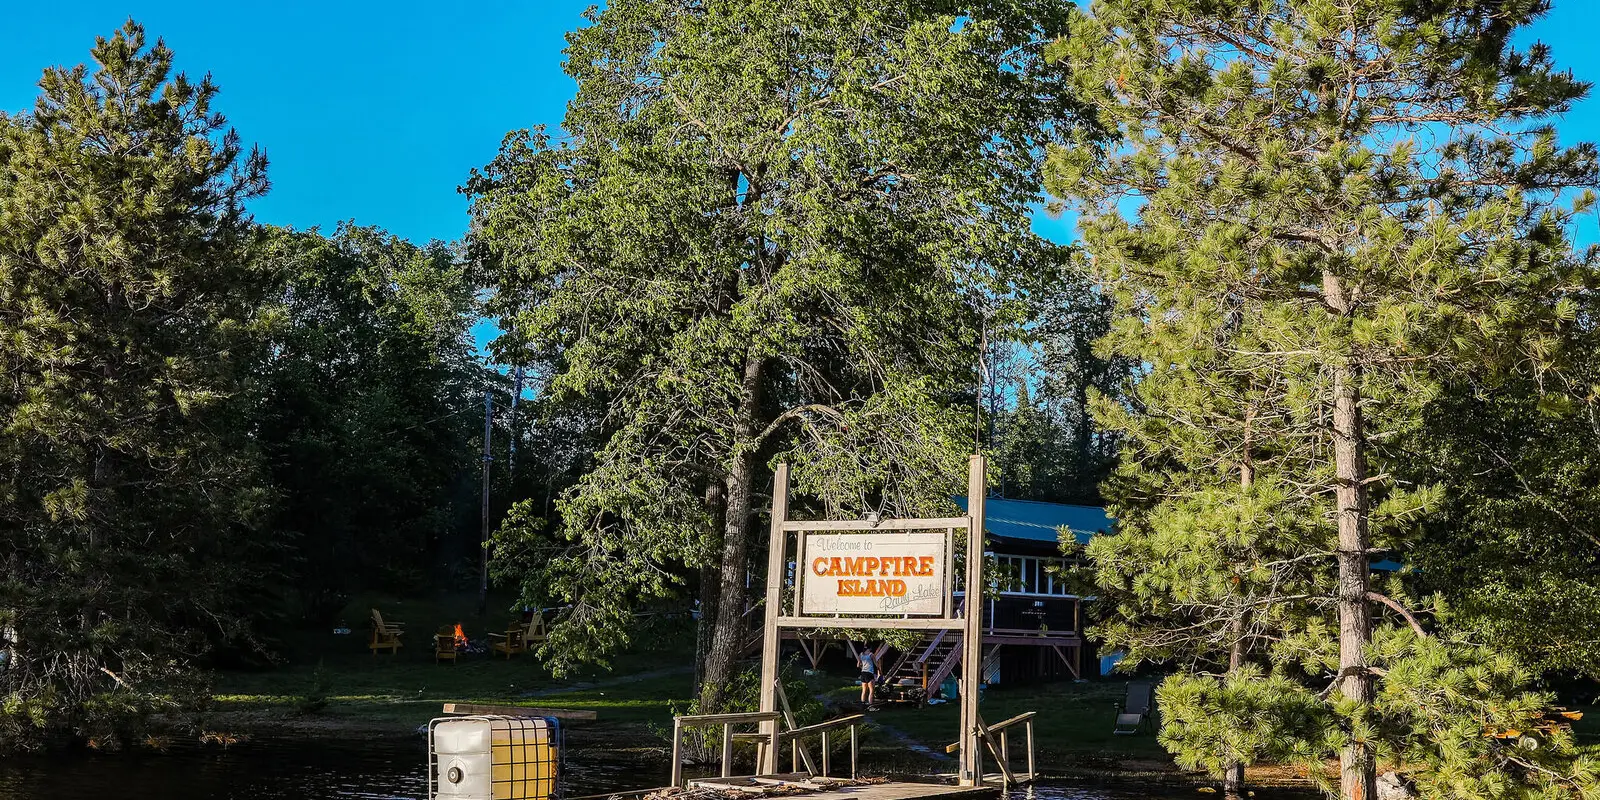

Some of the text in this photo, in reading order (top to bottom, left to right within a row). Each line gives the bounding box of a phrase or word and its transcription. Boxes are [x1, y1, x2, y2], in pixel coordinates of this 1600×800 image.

[816, 537, 873, 552] Welcome to
[812, 556, 935, 577] CAMPFIRE
[837, 579, 908, 597] ISLAND
[912, 583, 940, 600] Lake
